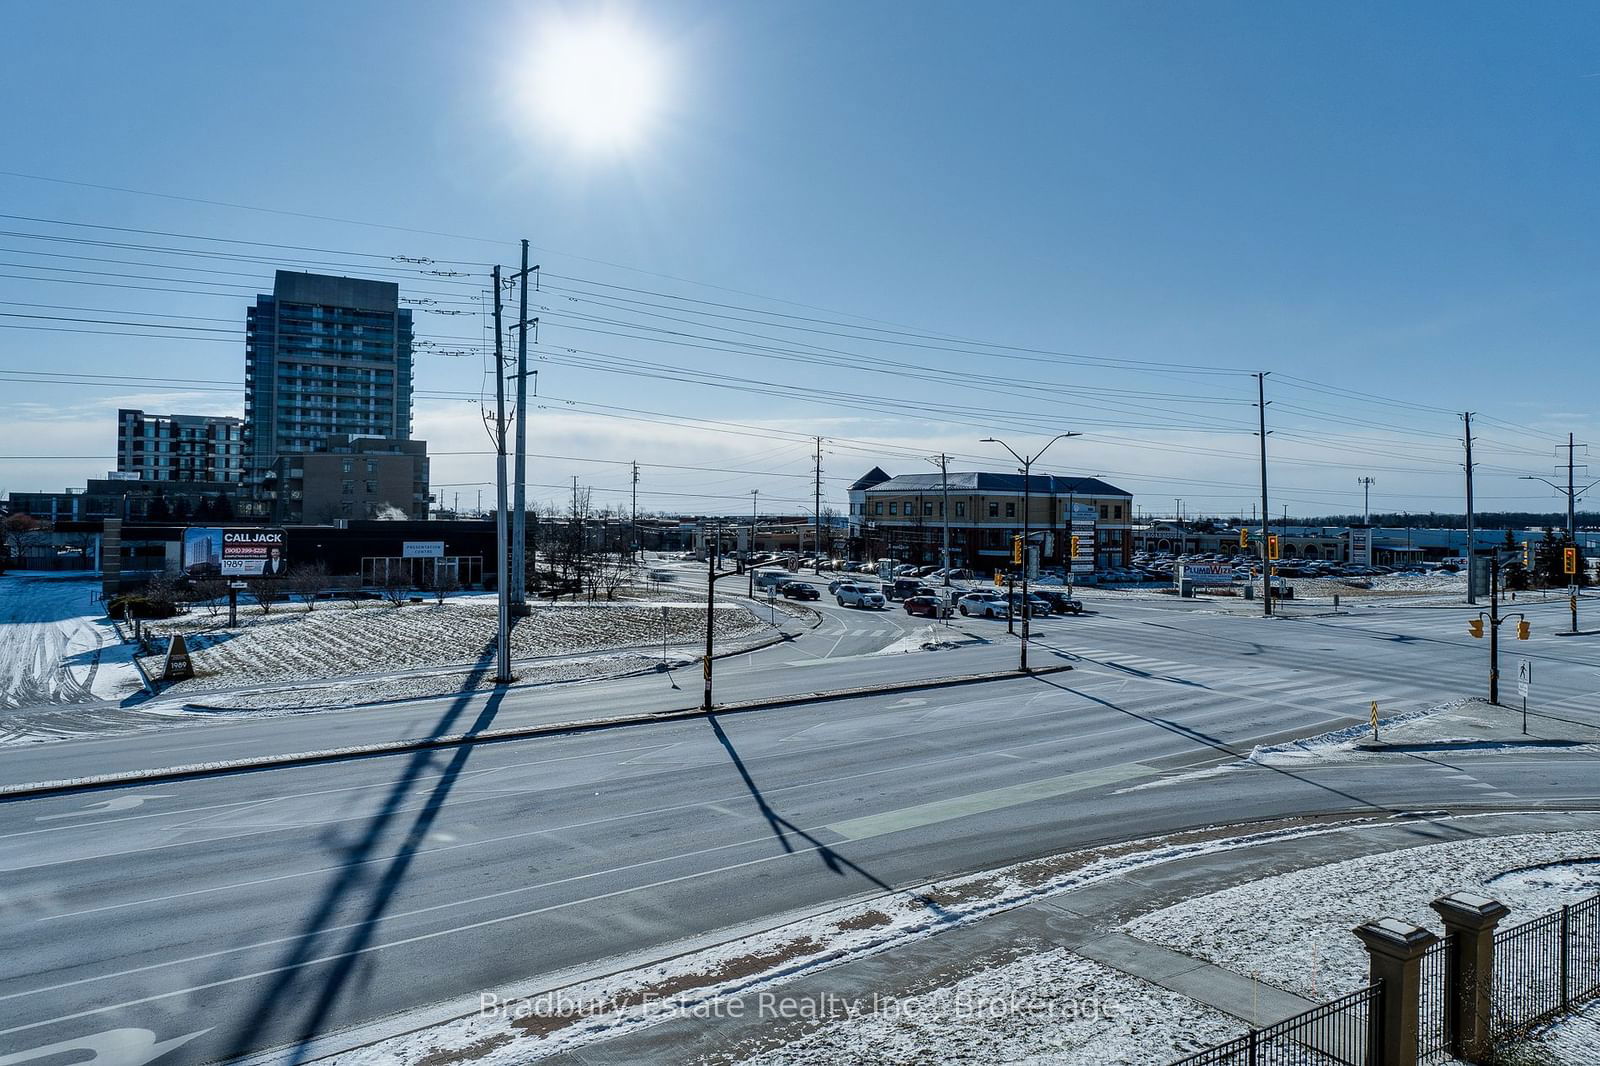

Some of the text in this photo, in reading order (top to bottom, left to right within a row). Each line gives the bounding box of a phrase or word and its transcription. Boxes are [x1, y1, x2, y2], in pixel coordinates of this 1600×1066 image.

[224, 533, 282, 542] CALL JACK
[223, 560, 243, 568] 1989
[170, 661, 187, 669] 1989
